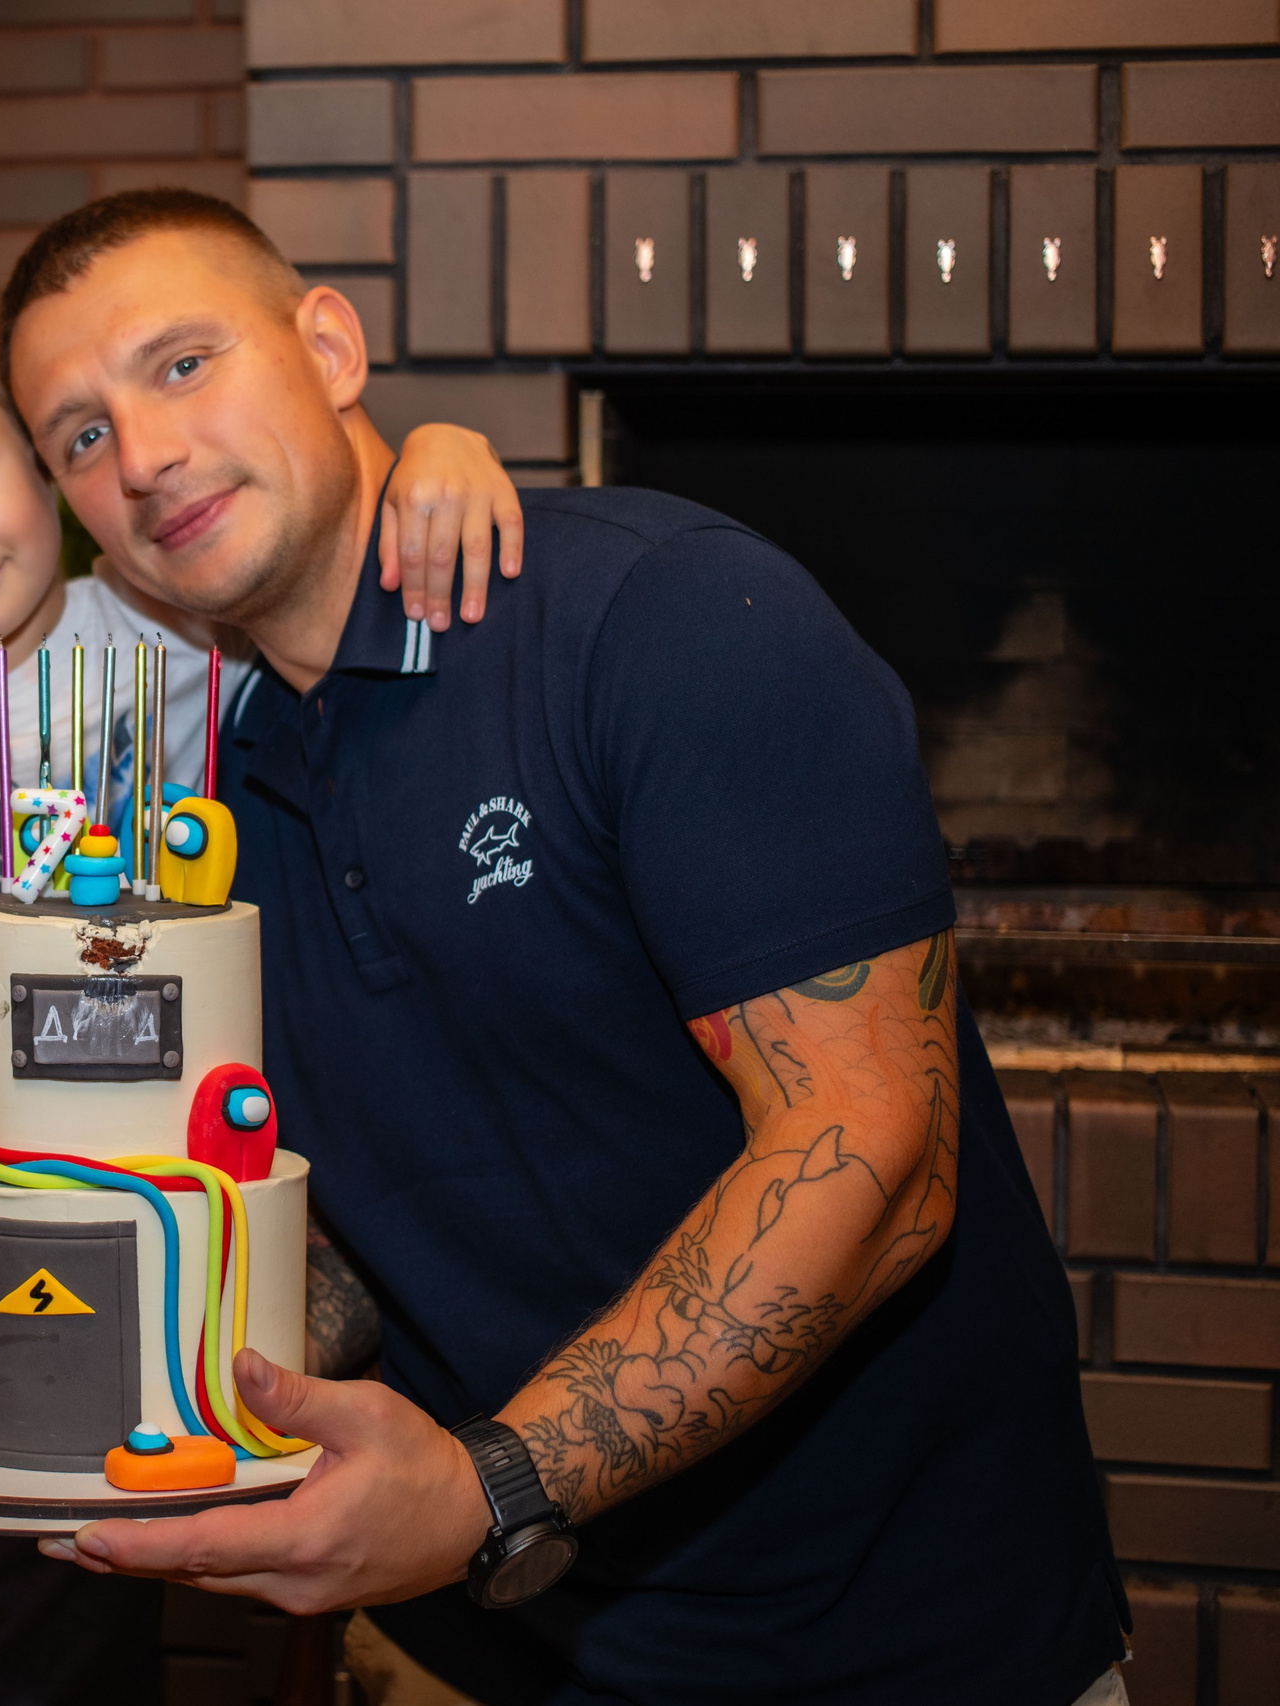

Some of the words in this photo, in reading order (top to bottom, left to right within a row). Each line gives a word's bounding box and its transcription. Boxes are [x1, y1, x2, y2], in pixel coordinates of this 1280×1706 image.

[10, 788, 88, 904] 7
[458, 812, 480, 852] PAUL
[478, 803, 489, 819] &
[488, 796, 532, 829] SHARK
[467, 855, 534, 904] yachting
